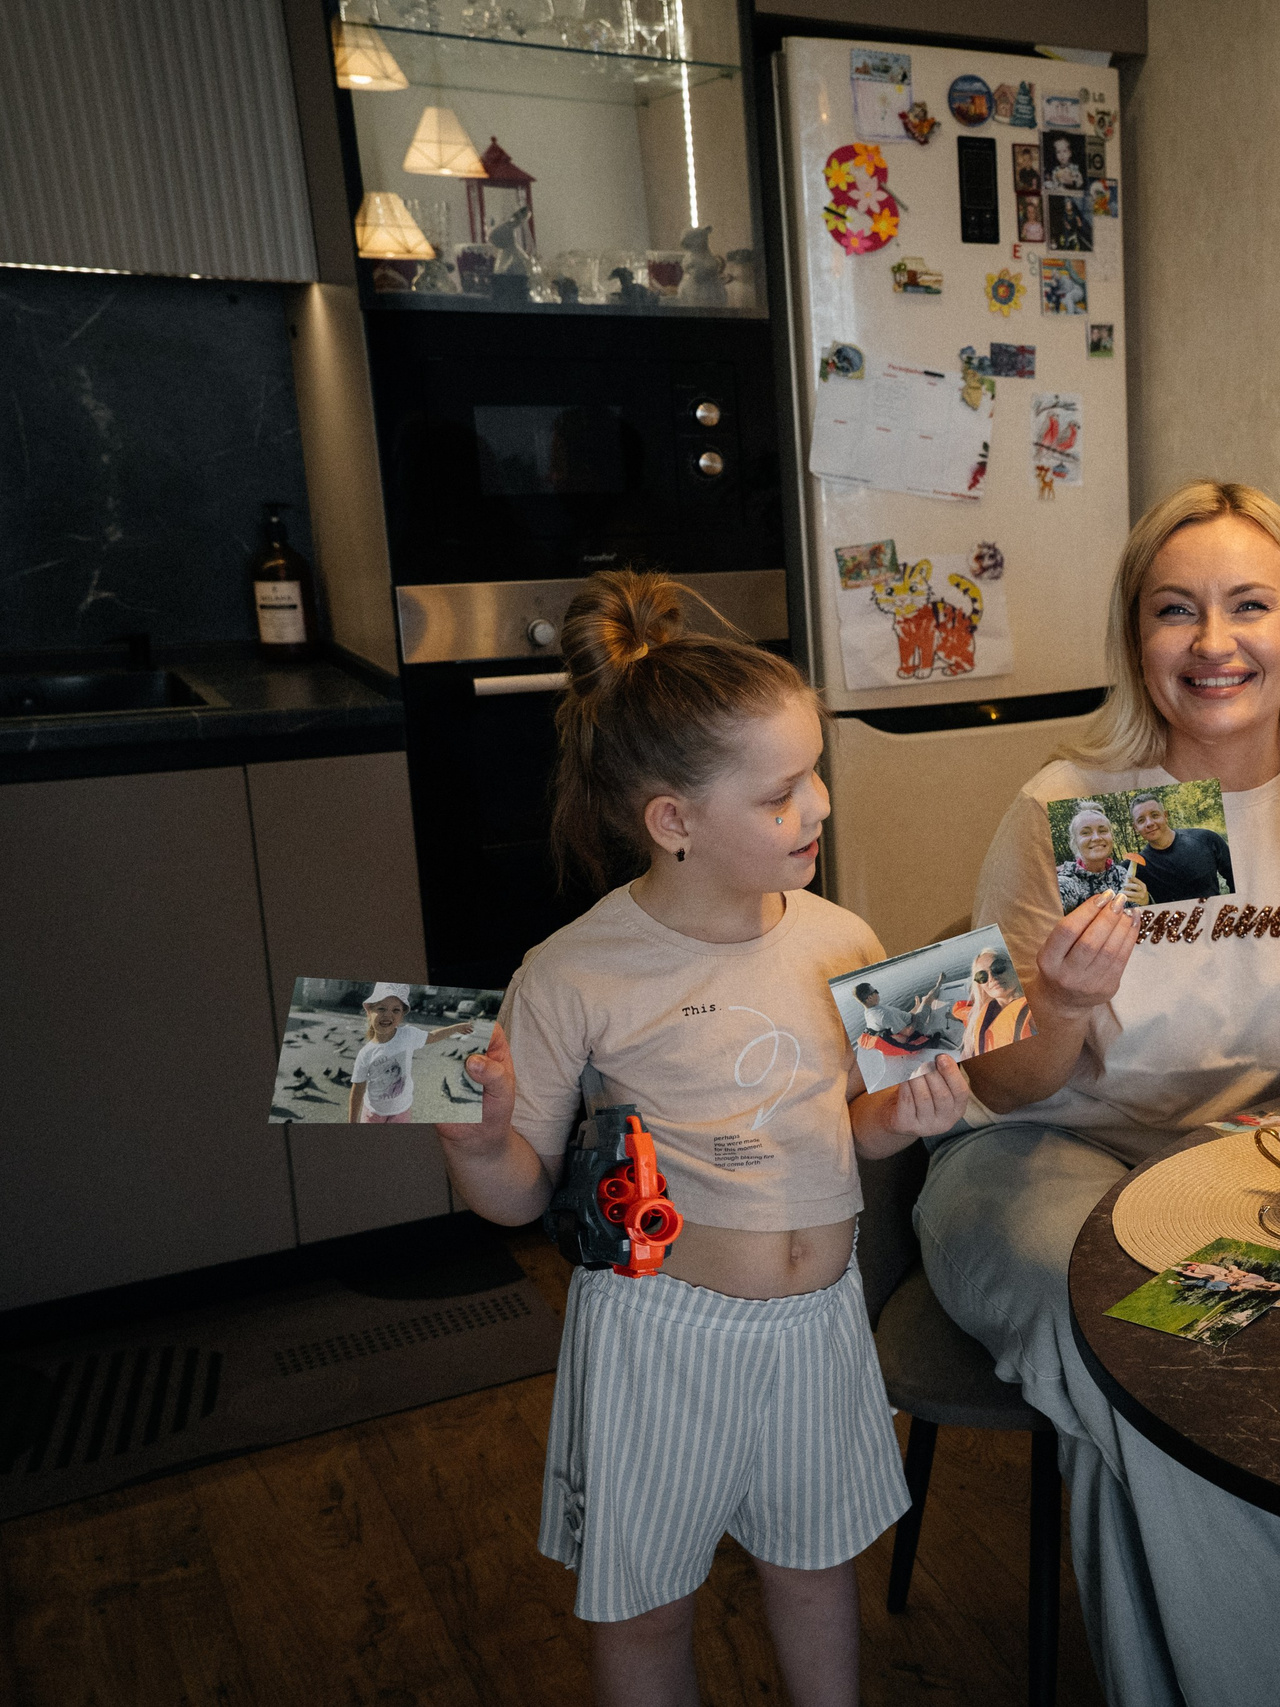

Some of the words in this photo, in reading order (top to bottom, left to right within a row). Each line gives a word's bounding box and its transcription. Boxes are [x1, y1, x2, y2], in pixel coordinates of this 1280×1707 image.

[1136, 898, 1204, 944] mi
[714, 1134, 740, 1142] perhaps
[737, 1143, 763, 1151] moment
